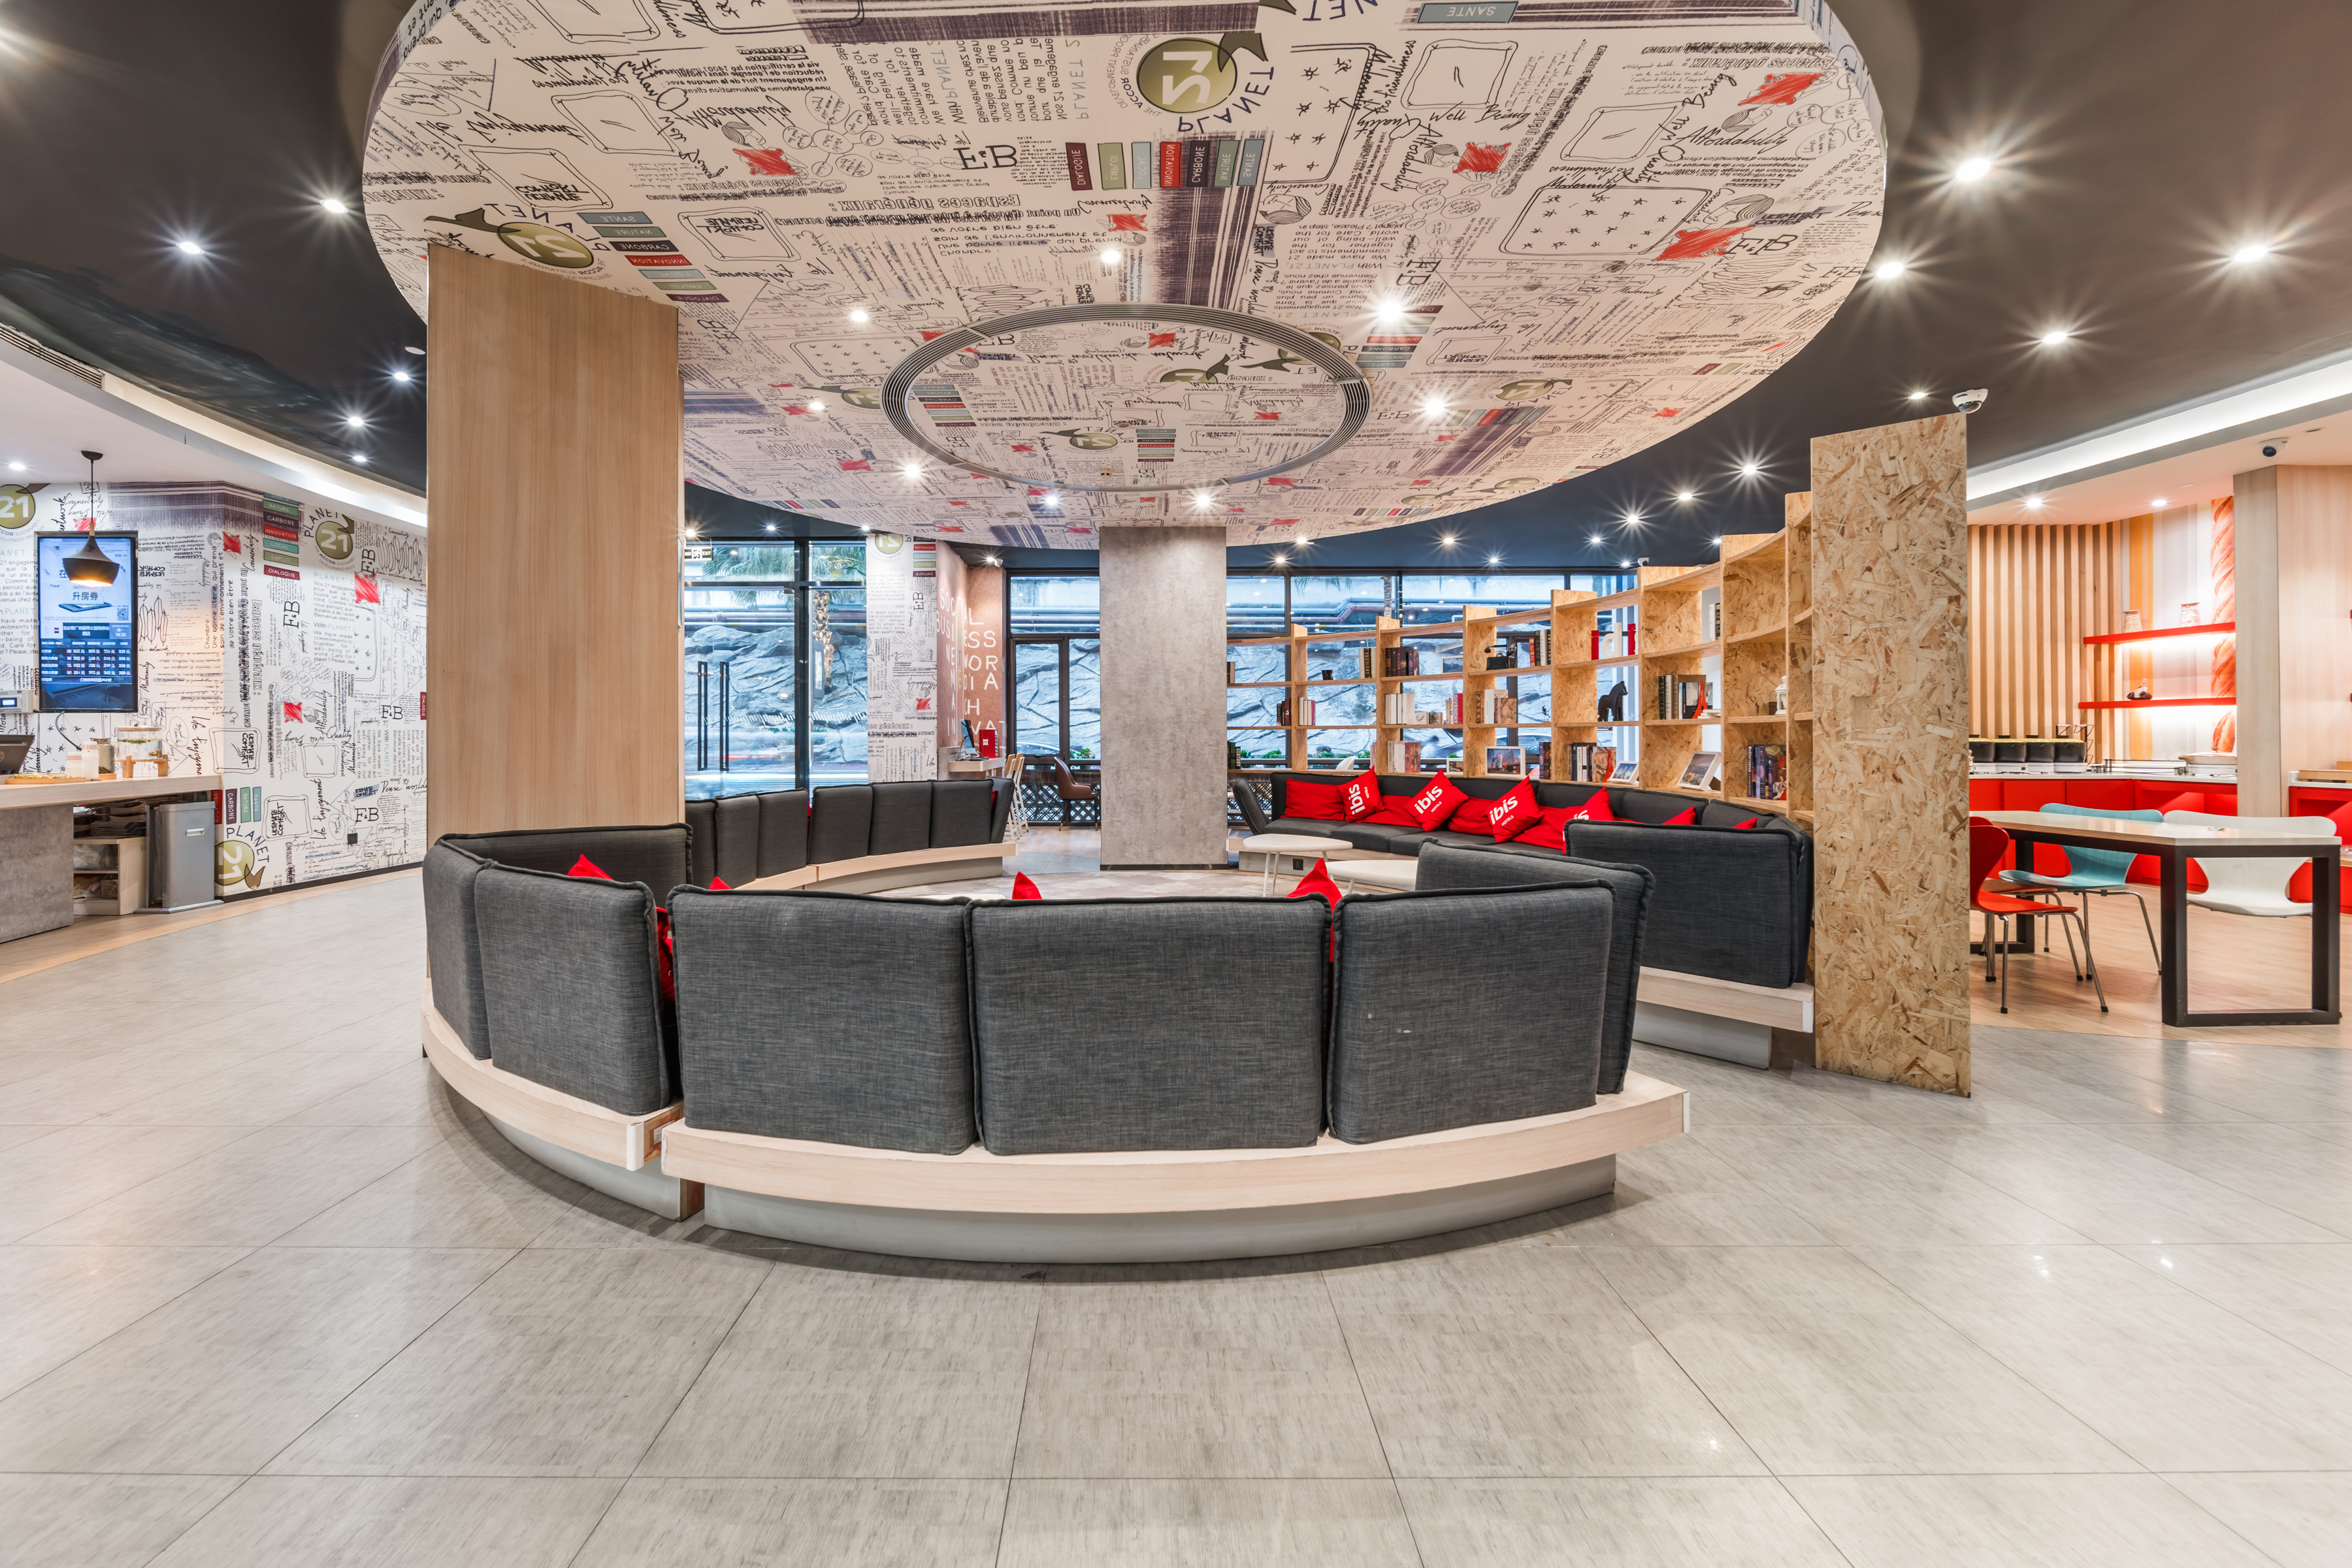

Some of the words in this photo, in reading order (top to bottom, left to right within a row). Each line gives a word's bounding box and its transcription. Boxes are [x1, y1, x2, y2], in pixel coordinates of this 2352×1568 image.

[1446, 6, 1496, 16] SANTE
[1429, 101, 1467, 121] Well
[0, 496, 29, 517] 21
[269, 503, 289, 512] NATURE
[267, 516, 295, 525] CARBONE
[265, 529, 297, 539] INNOVATION
[320, 529, 348, 552] 21
[319, 553, 336, 565] ACCOR
[73, 592, 98, 600] 升房券
[1348, 784, 1365, 815] ibis
[1414, 786, 1443, 814] ibis
[1431, 801, 1442, 813] HOTELS
[1490, 796, 1518, 825] ibis
[1501, 815, 1514, 826] HOTELS
[226, 825, 269, 862] PLANET
[218, 845, 243, 879] 21
